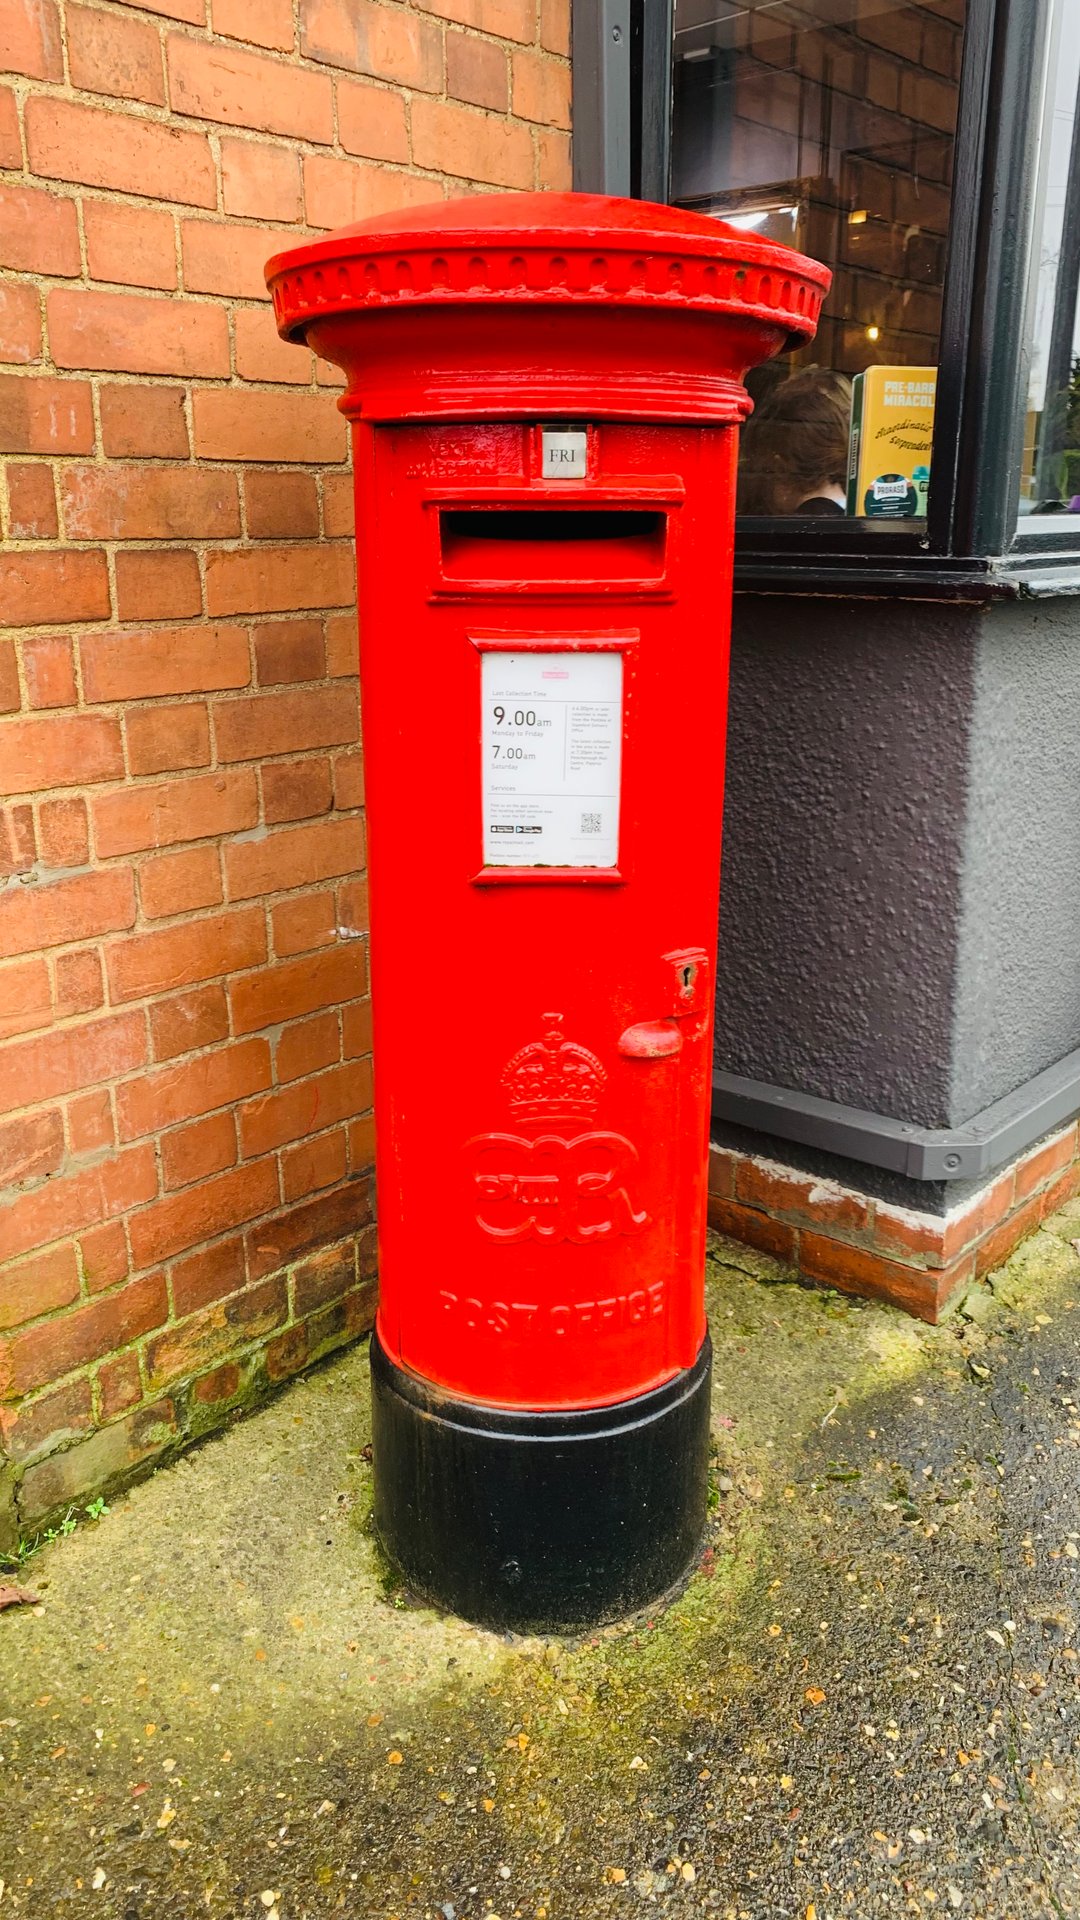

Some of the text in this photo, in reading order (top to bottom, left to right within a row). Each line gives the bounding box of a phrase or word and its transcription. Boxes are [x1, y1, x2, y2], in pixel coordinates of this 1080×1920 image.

[550, 449, 575, 462] FRI
[493, 705, 552, 727] 9.00am
[492, 730, 515, 738] Monday
[525, 731, 544, 739] Friday
[492, 745, 536, 760] 7.00am
[491, 763, 518, 771] Saturday
[439, 1281, 667, 1338] POST OFFICE
